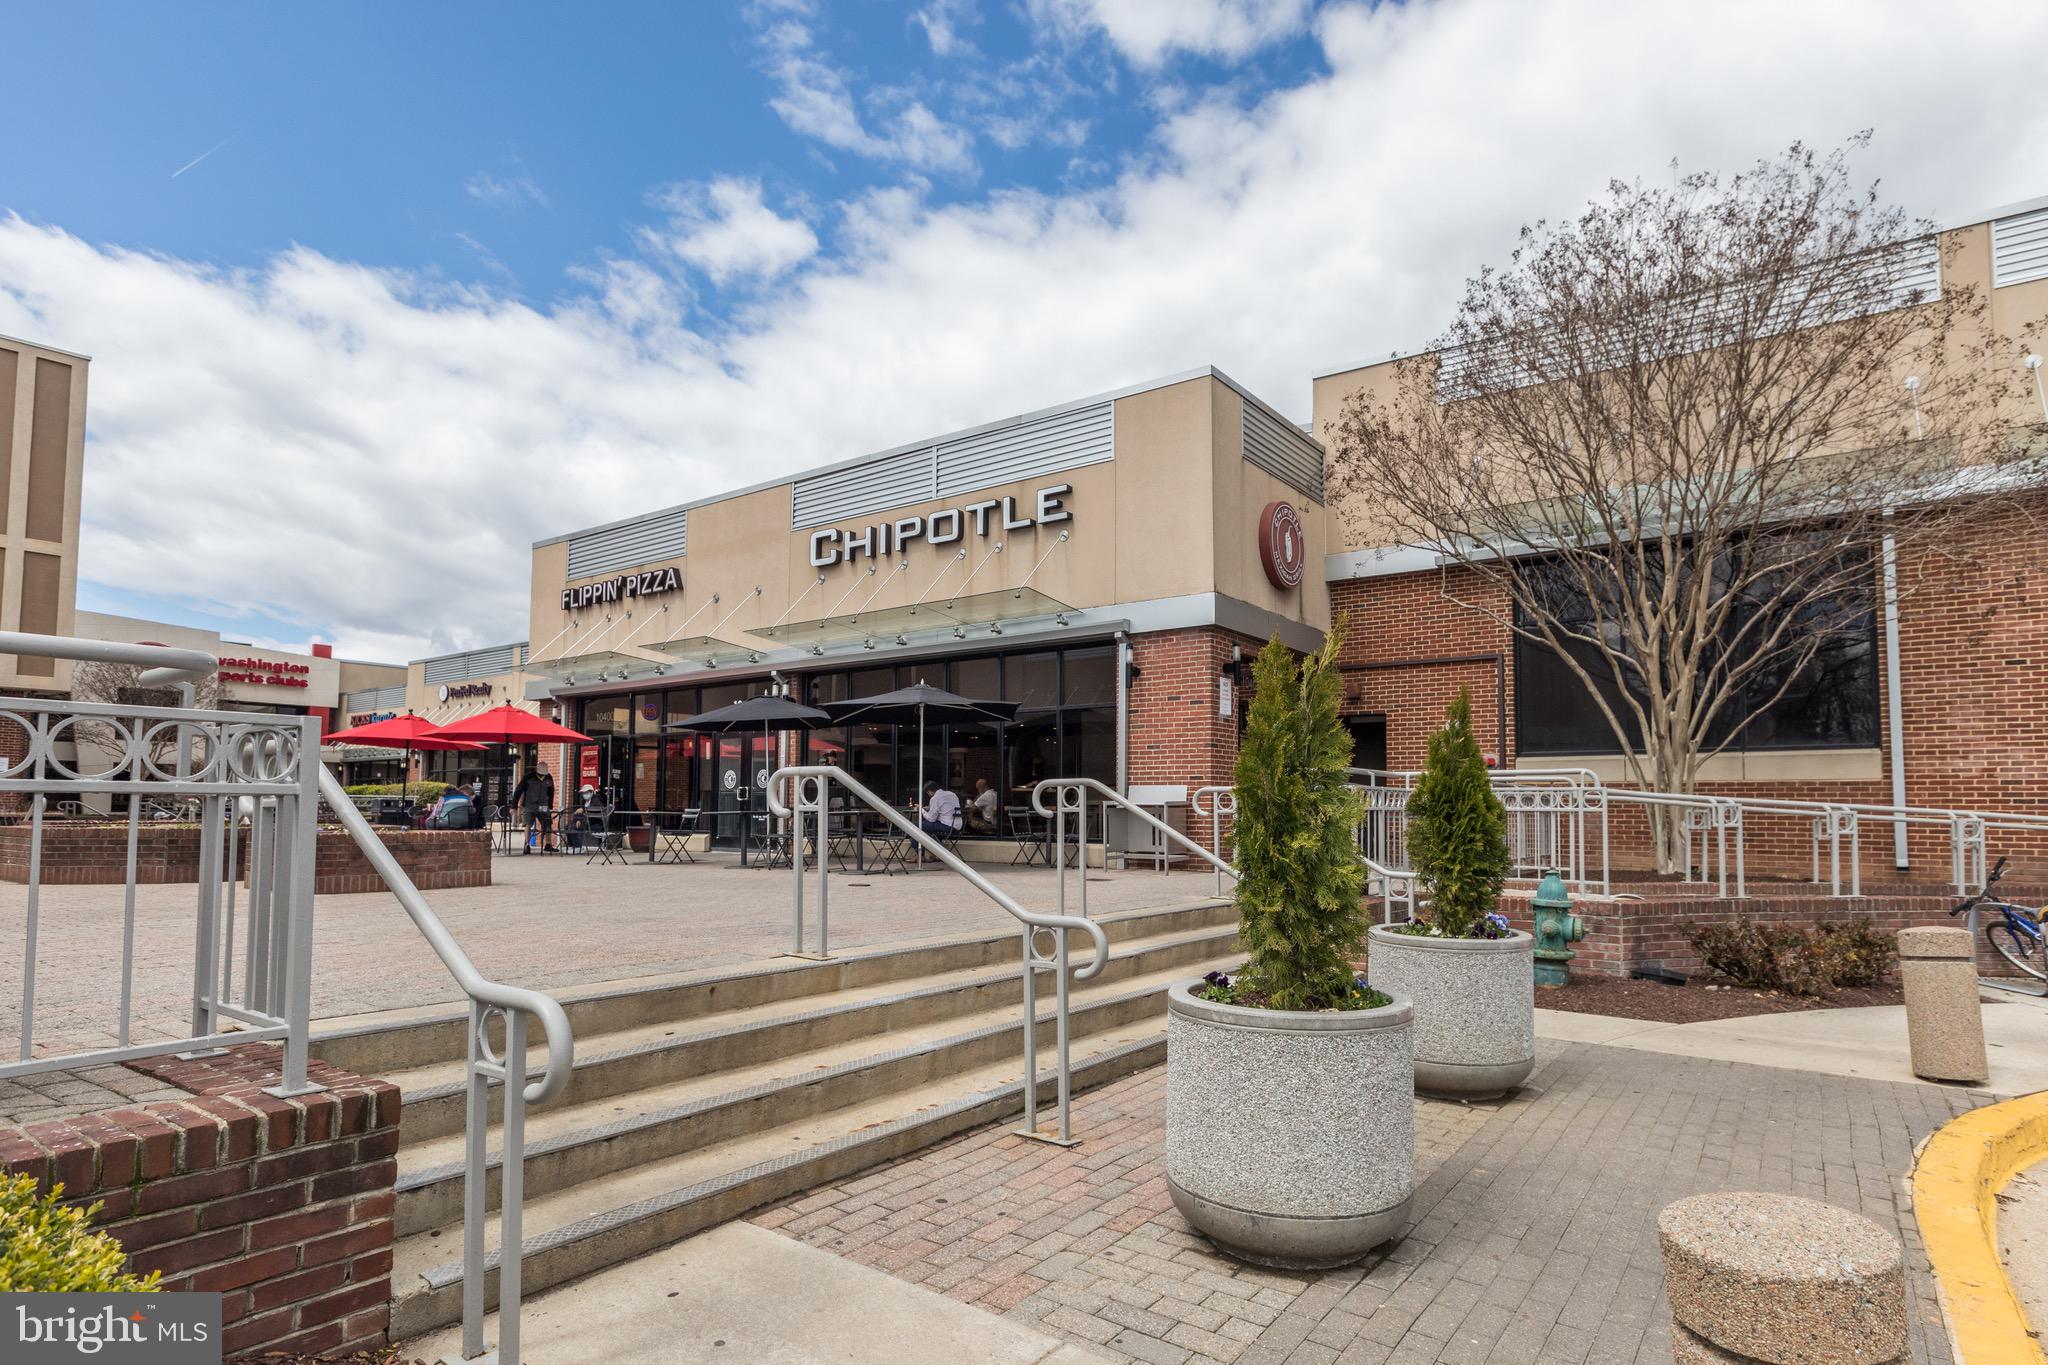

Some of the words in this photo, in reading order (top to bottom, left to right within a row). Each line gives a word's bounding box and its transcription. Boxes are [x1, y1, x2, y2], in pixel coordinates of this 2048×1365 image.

[809, 484, 1073, 568] CHIPOTLE
[561, 575, 624, 610] FLIPPIN'
[625, 567, 681, 598] PIZZA
[218, 671, 264, 684] ports
[266, 674, 309, 689] clubs
